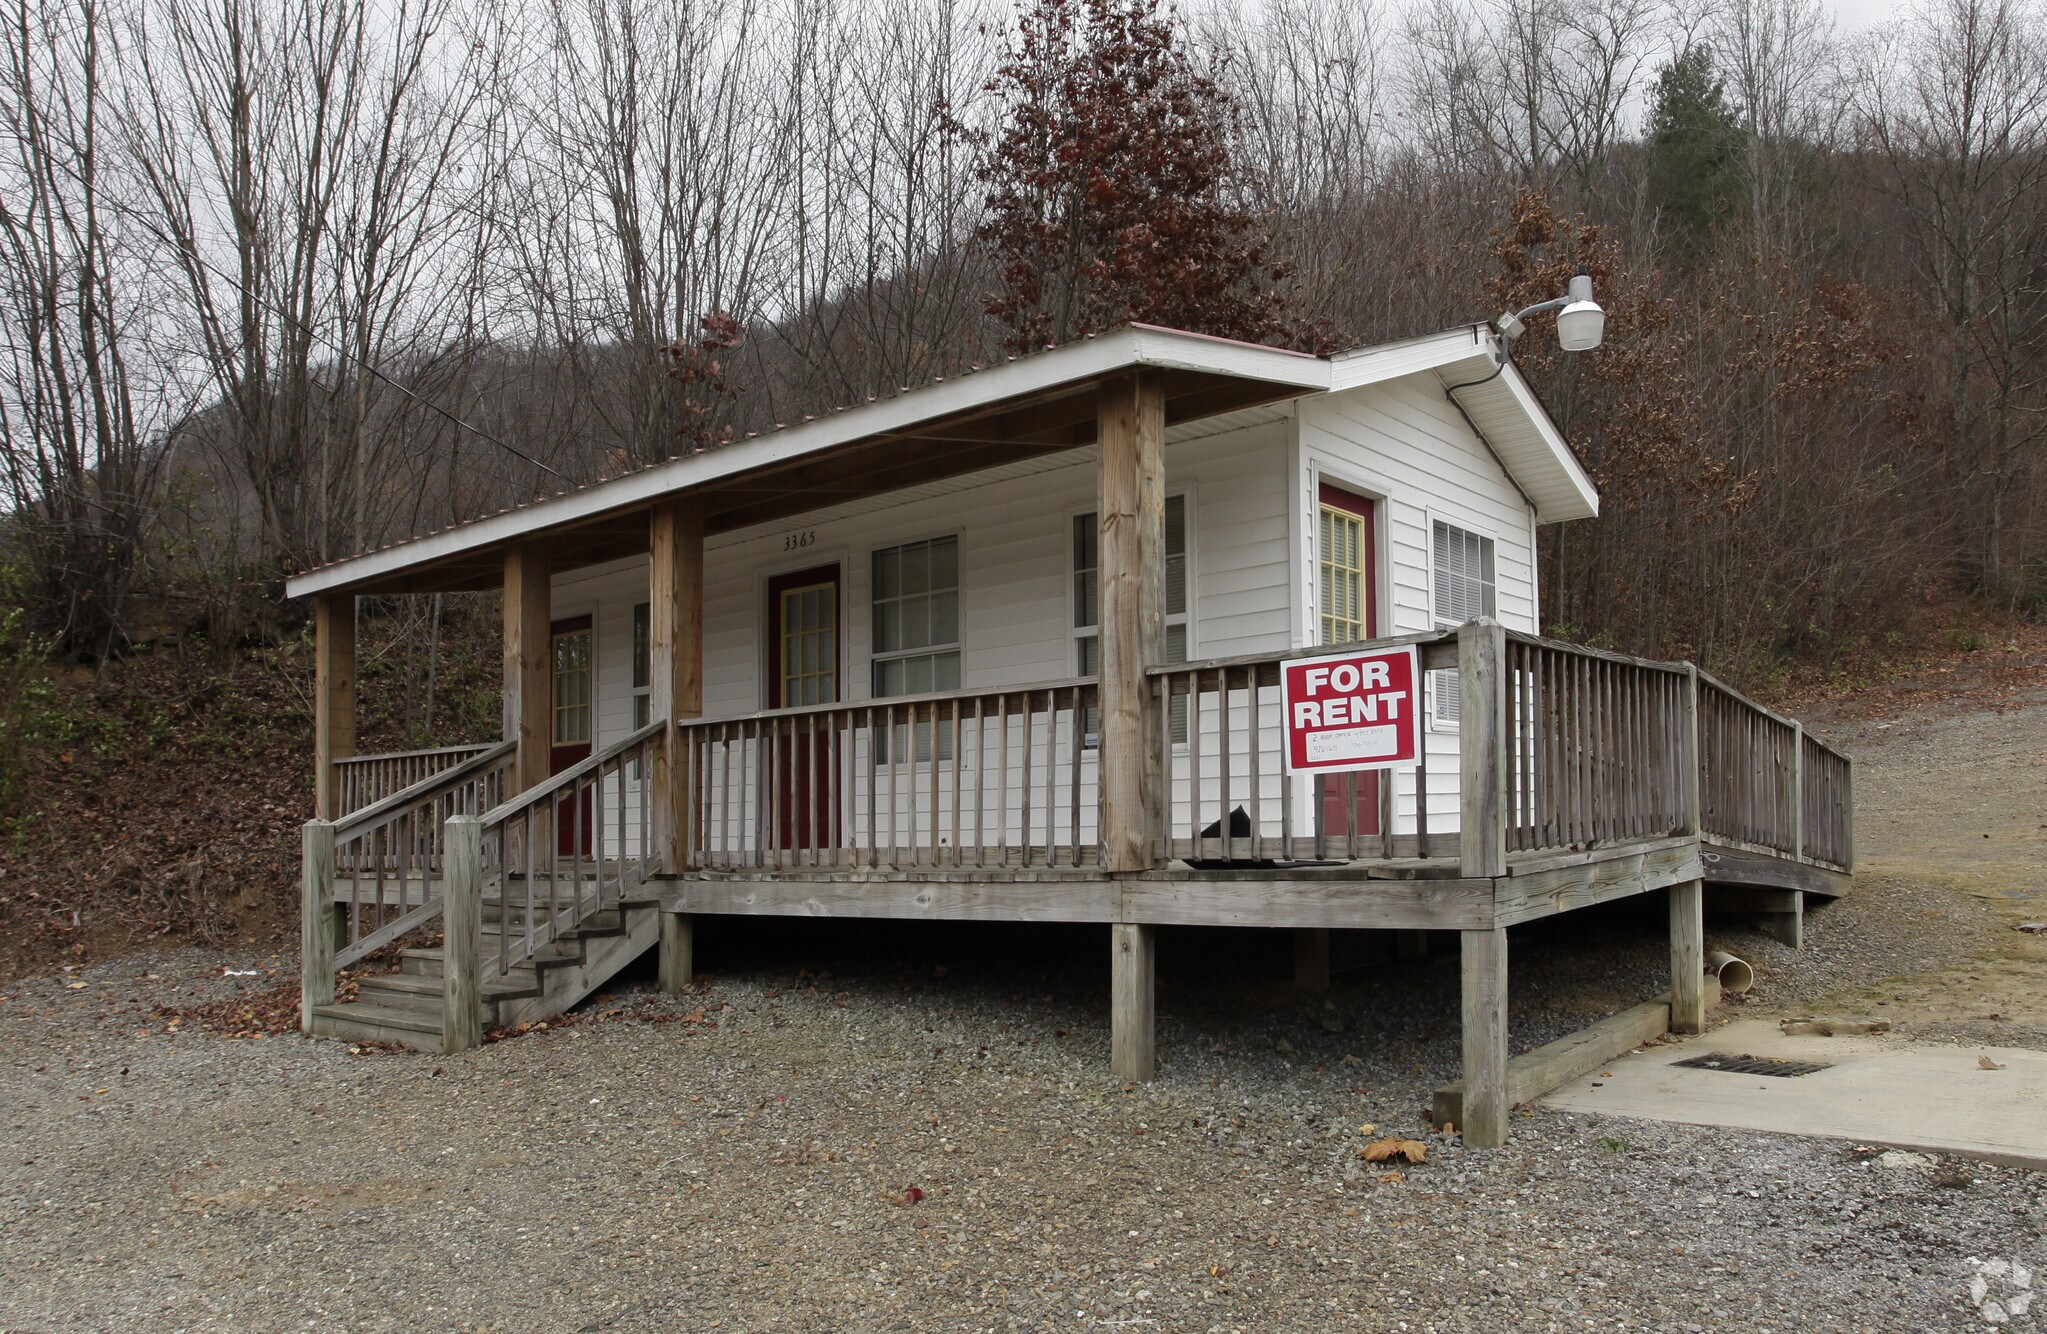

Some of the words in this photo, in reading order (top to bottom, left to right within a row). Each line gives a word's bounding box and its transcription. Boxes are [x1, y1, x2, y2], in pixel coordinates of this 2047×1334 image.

[783, 531, 816, 552] 3365
[1305, 661, 1391, 696] FOR
[1294, 691, 1407, 729] RENT
[1312, 733, 1318, 743] 2
[1320, 733, 1334, 741] ROOM
[1335, 731, 1351, 739] OFFICE
